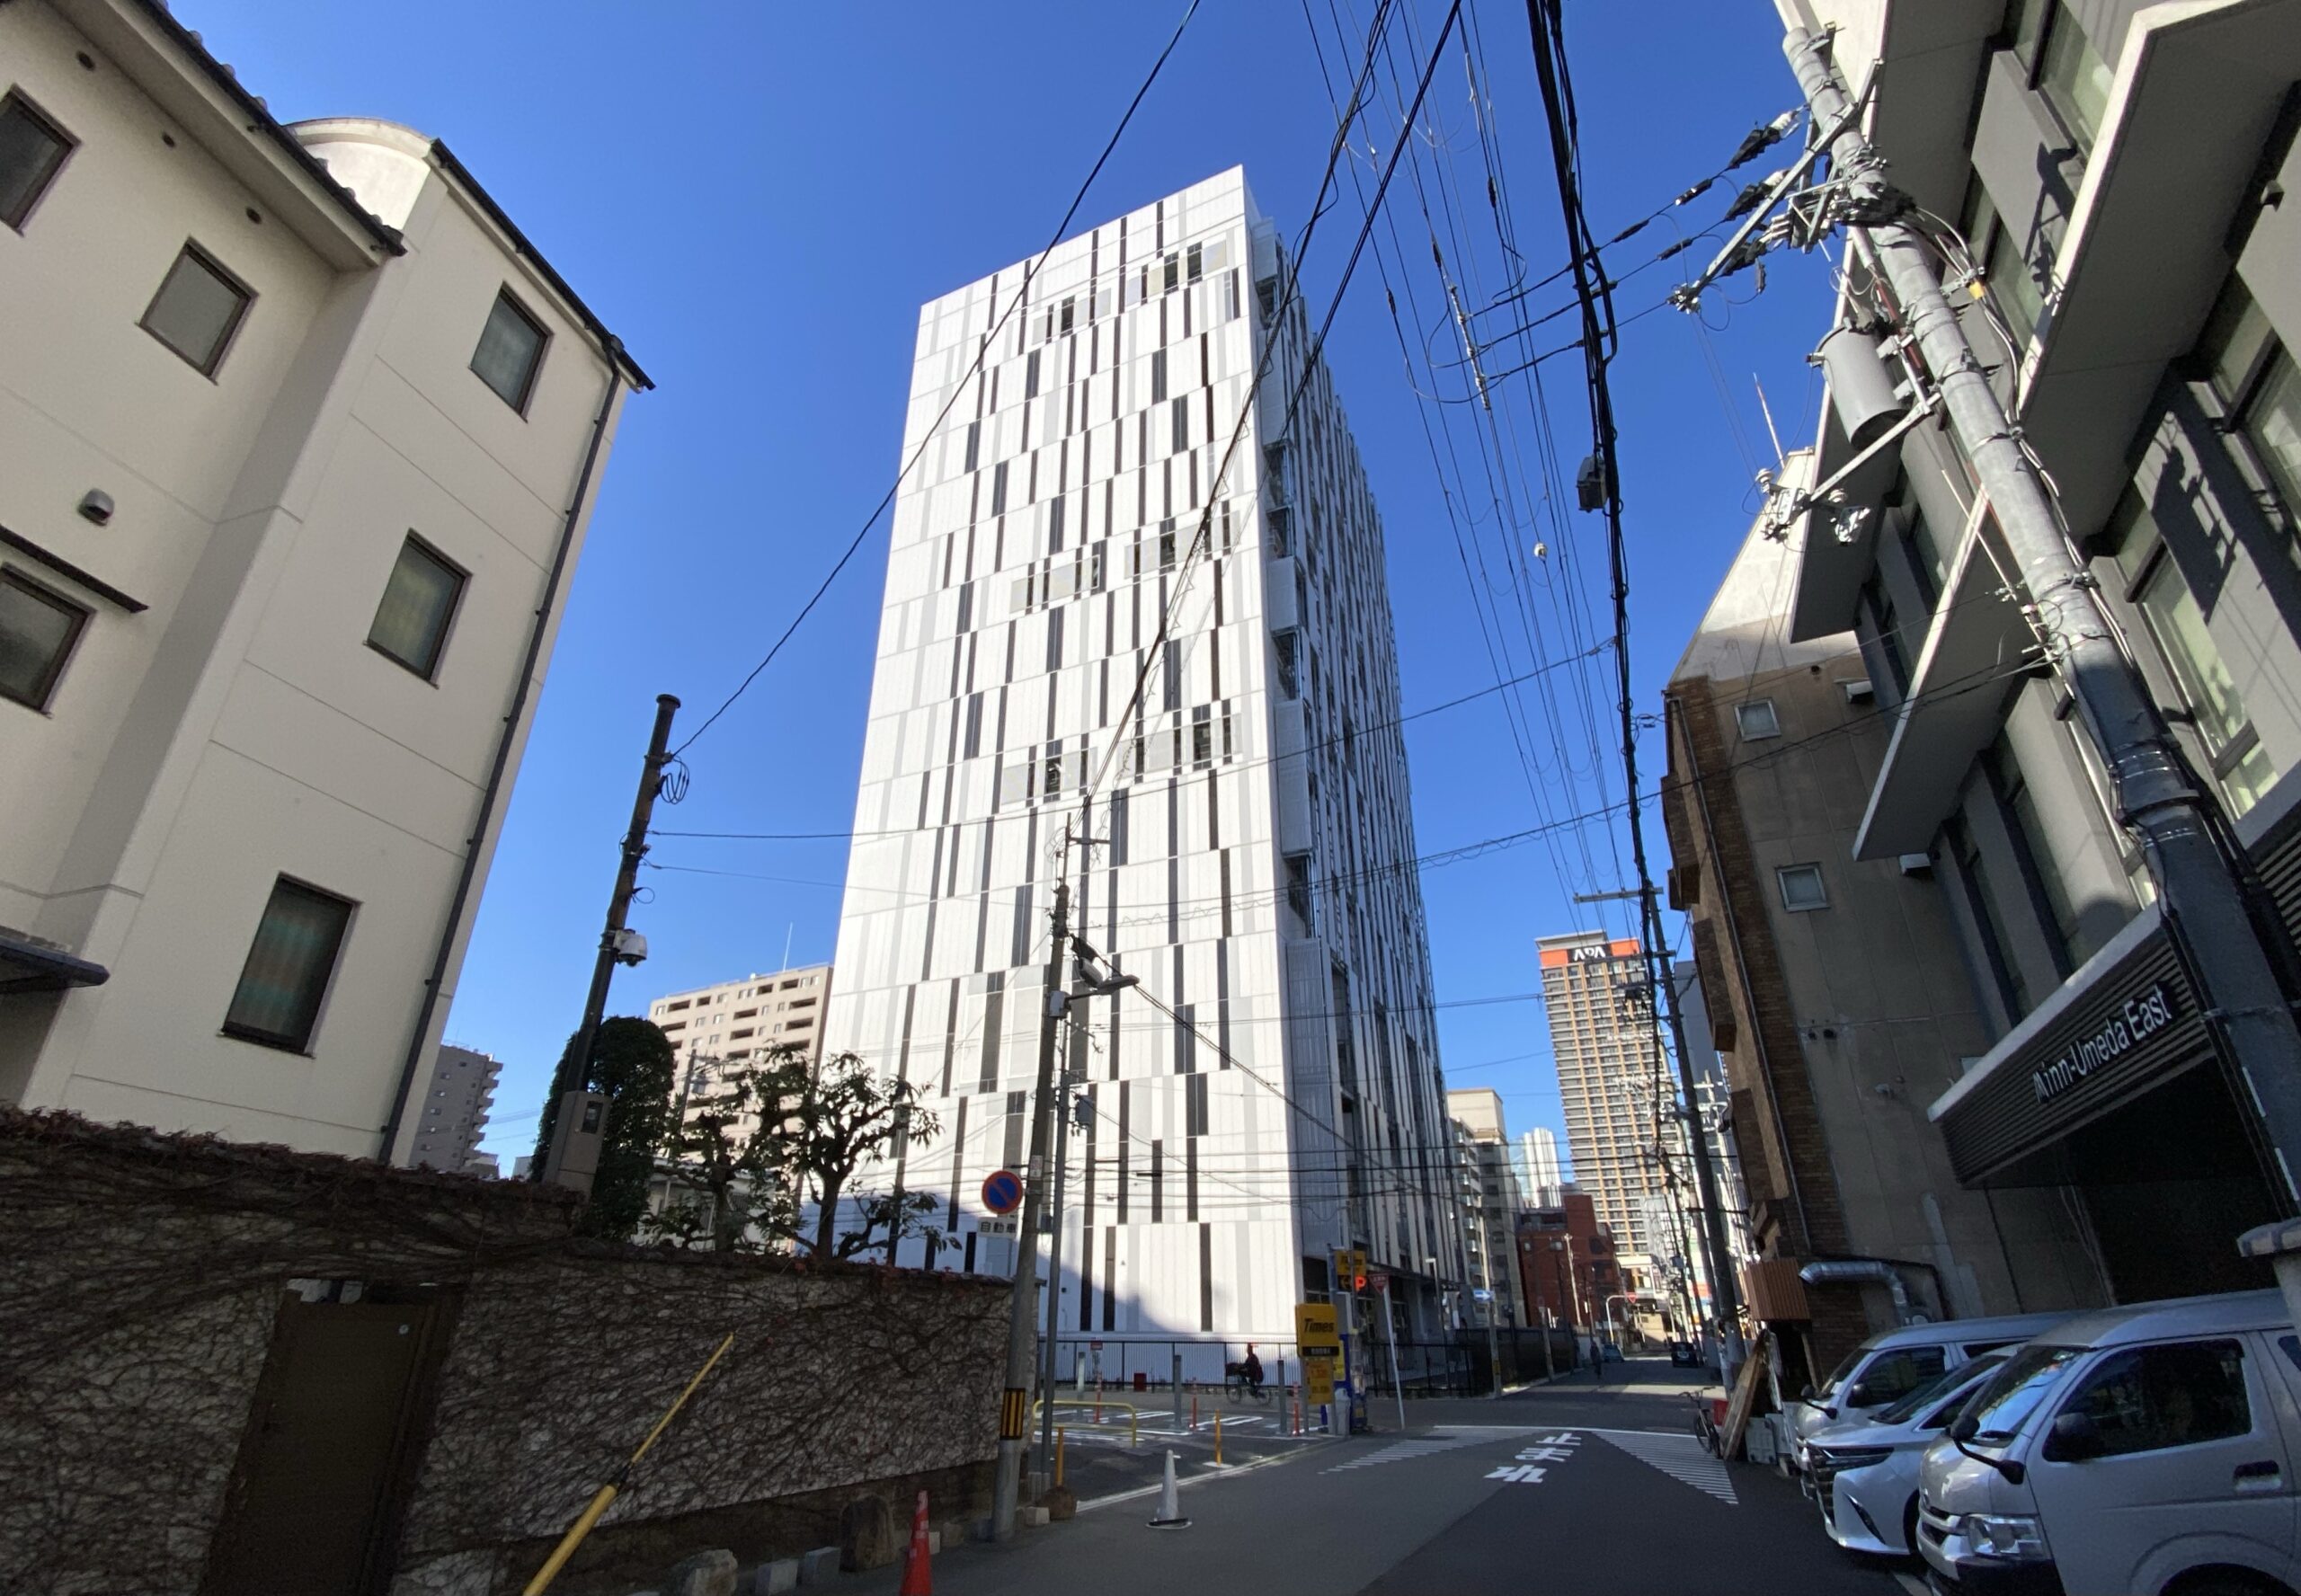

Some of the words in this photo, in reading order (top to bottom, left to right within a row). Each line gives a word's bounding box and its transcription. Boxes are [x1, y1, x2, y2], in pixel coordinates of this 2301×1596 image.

[2032, 1017, 2130, 1104] Minn-Umeda
[2124, 984, 2172, 1041] East
[1303, 1317, 1334, 1333] Times
[1483, 1432, 1582, 1483] 止まれ
